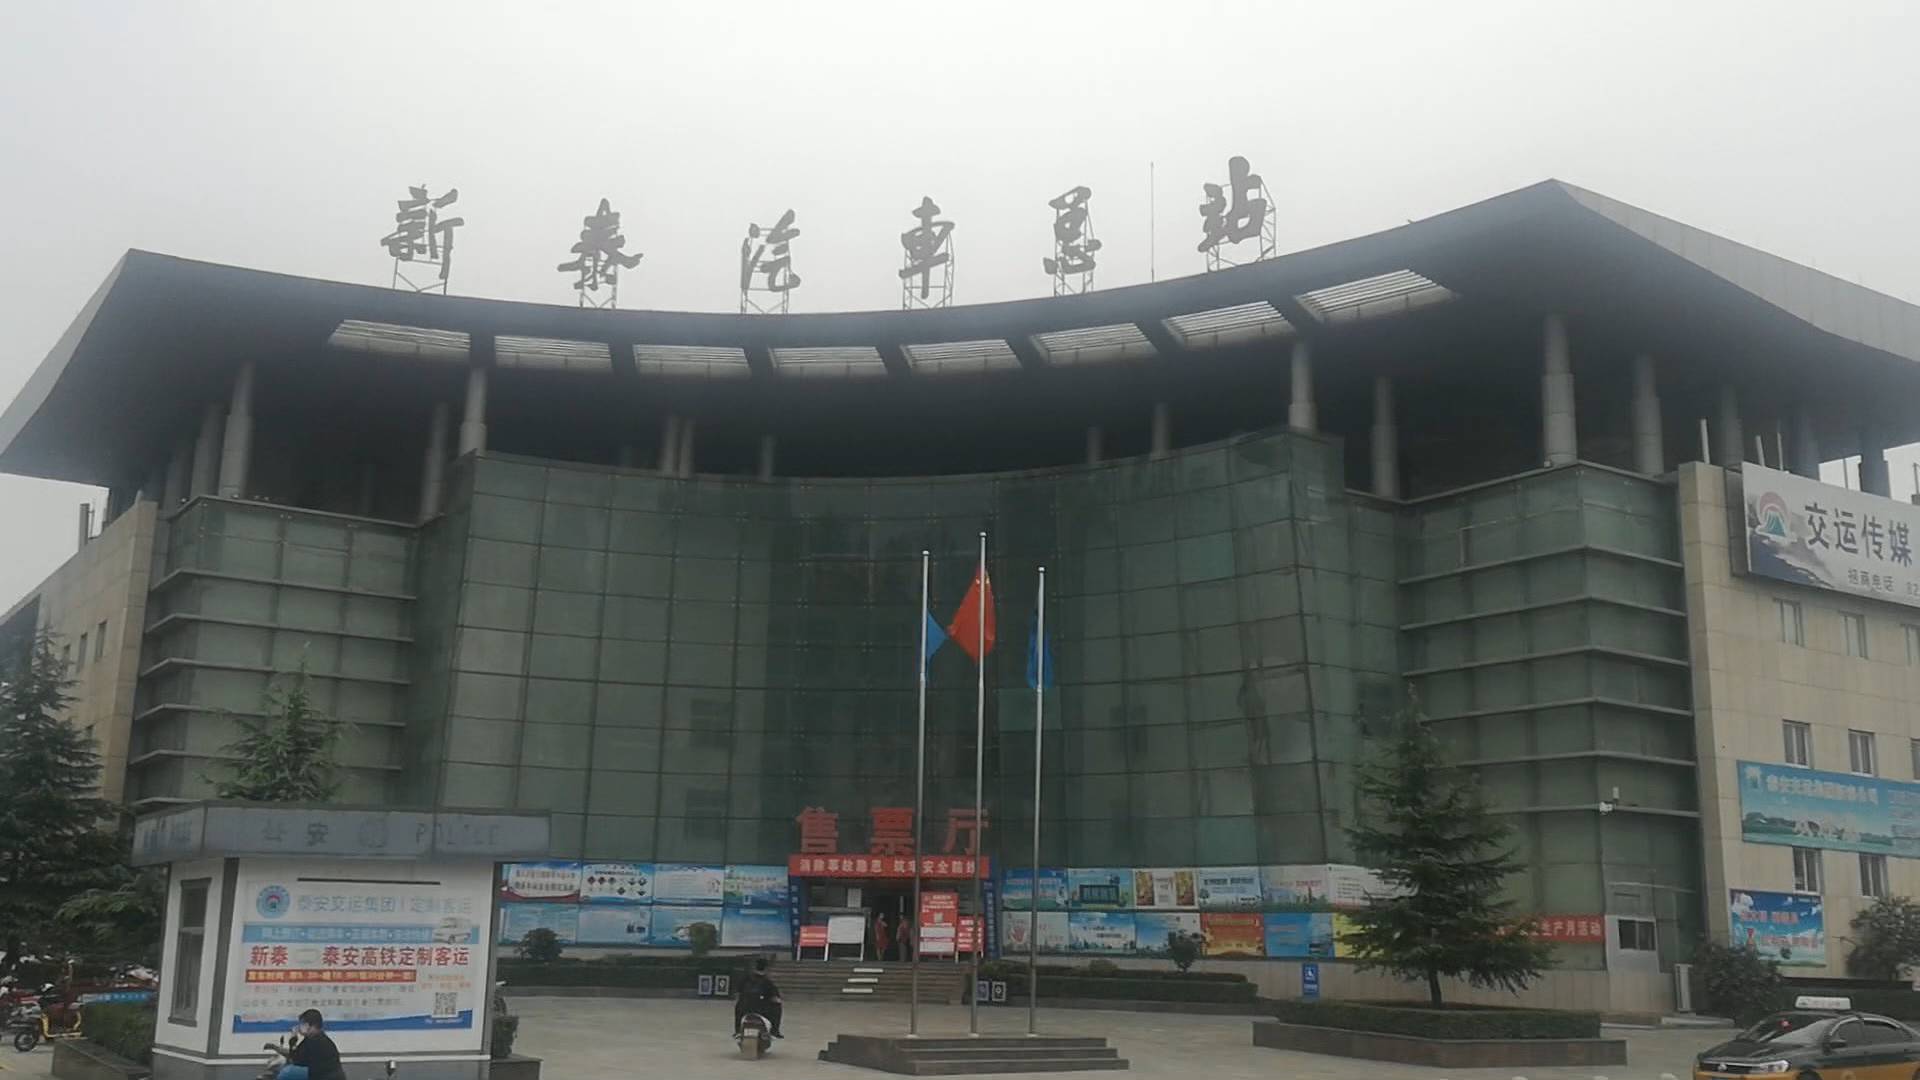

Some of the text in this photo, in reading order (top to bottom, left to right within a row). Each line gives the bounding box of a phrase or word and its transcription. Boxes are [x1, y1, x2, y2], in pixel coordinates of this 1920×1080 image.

[1804, 502, 1912, 567] 交运传媒
[795, 806, 989, 856] 售票厅
[799, 858, 883, 873] 消除事故隐患
[250, 945, 470, 967] 新泰 泰安高铁定制客运
